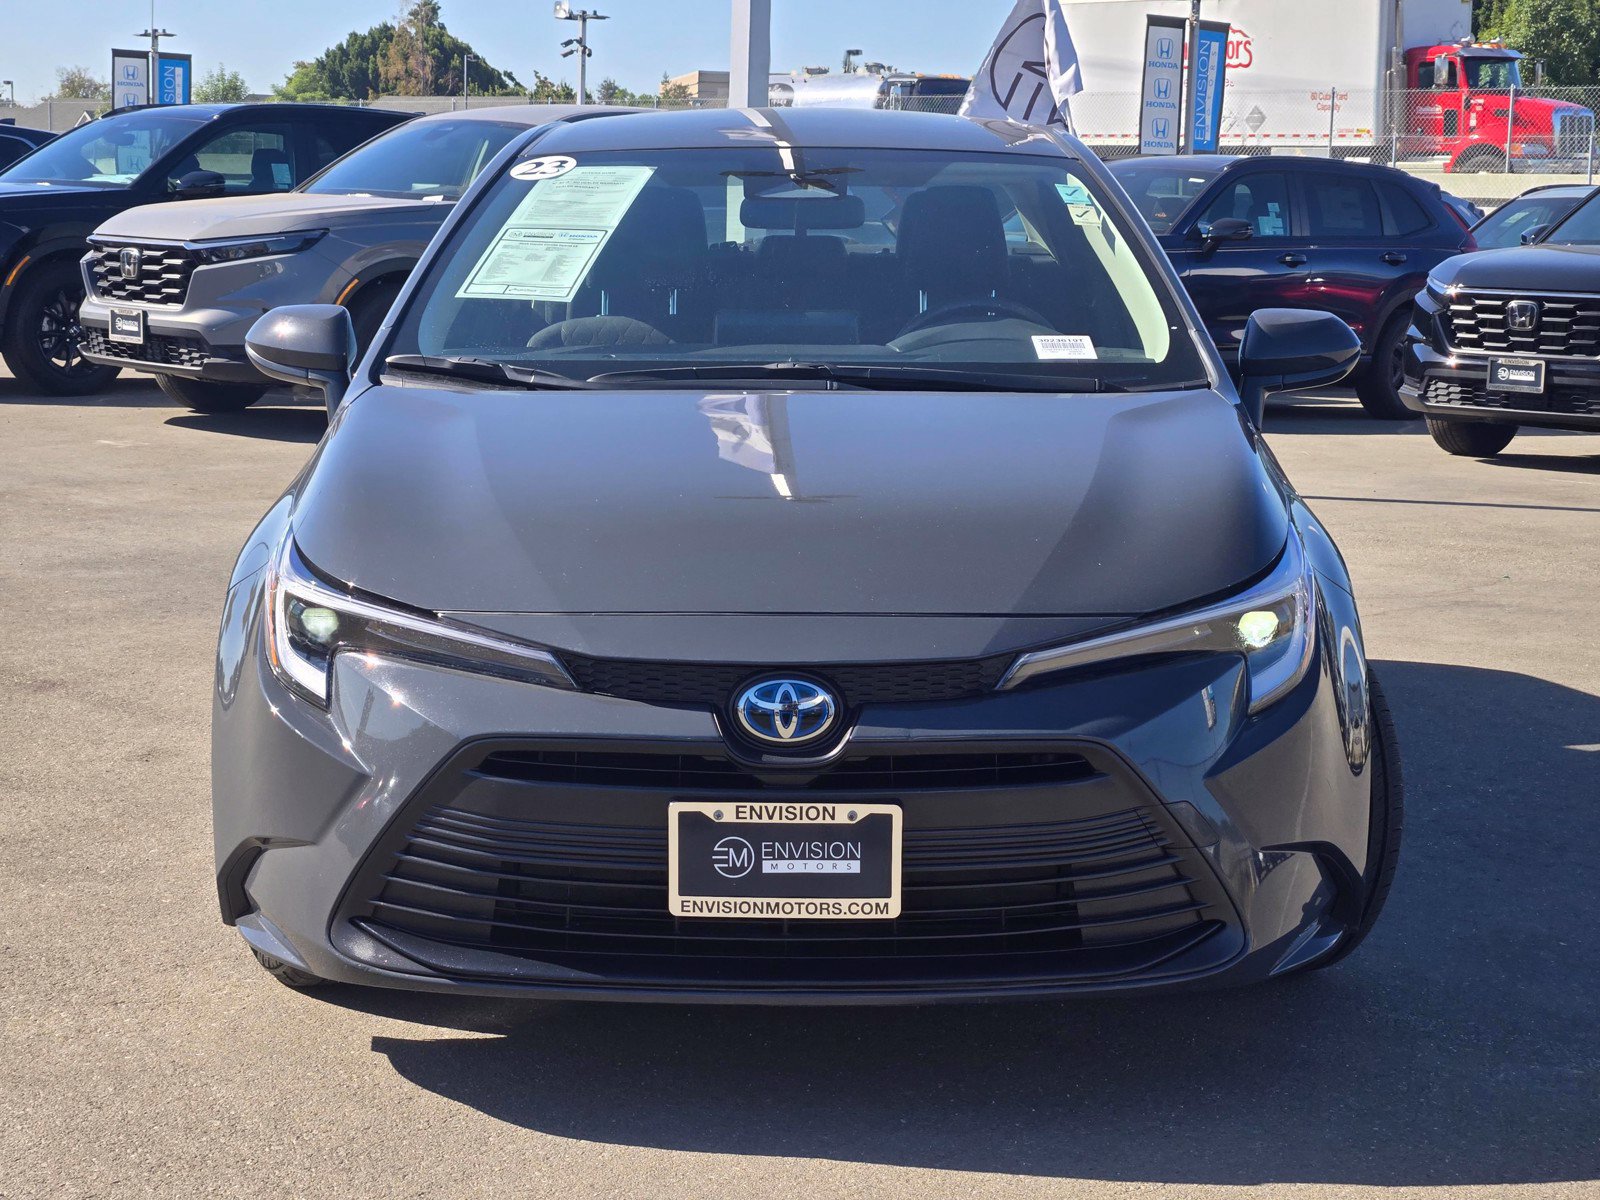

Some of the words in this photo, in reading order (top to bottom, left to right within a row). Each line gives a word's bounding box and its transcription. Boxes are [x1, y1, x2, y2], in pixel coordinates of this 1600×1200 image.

[1148, 60, 1179, 70] HONDA
[1194, 39, 1211, 141] ENVISION
[1145, 100, 1177, 110] HONDA
[1143, 140, 1175, 149] HONDA
[516, 159, 569, 177] 23
[734, 804, 836, 821] ENVISION
[761, 841, 861, 859] ENVISION
[770, 861, 852, 871] MOTORS
[680, 899, 890, 916] ENVISIONMOTORS.COM
